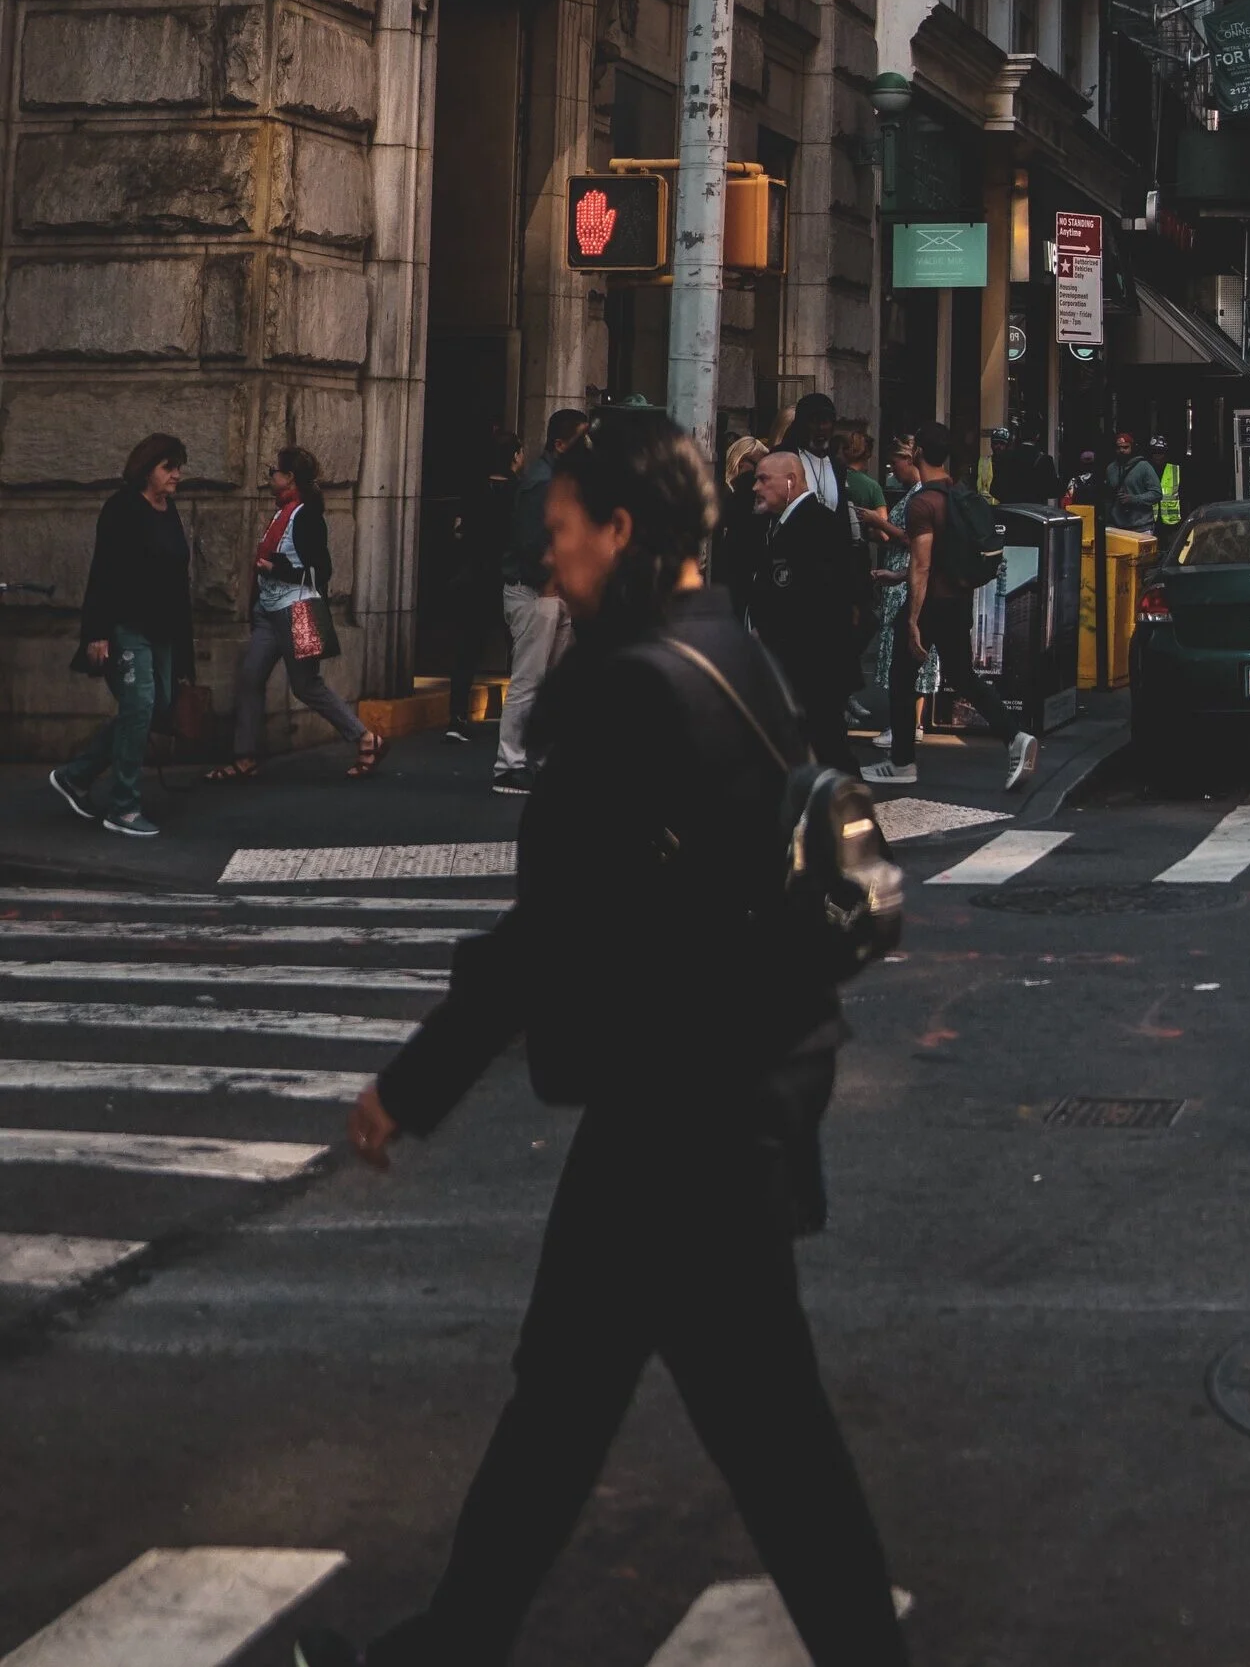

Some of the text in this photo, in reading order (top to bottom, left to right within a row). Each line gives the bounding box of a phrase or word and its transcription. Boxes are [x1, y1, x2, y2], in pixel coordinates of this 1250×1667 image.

[1215, 51, 1245, 67] FOR
[1230, 86, 1247, 95] 212
[1232, 103, 1249, 112] 212
[1059, 217, 1094, 229] NO STANDING
[1059, 227, 1082, 238] Anytime
[1074, 258, 1099, 266] Authorized
[1074, 265, 1093, 273] Vehicles
[1074, 272, 1084, 280] Only
[1059, 284, 1077, 292] Housing
[1059, 291, 1088, 300] Development
[1059, 299, 1086, 308] Corporation
